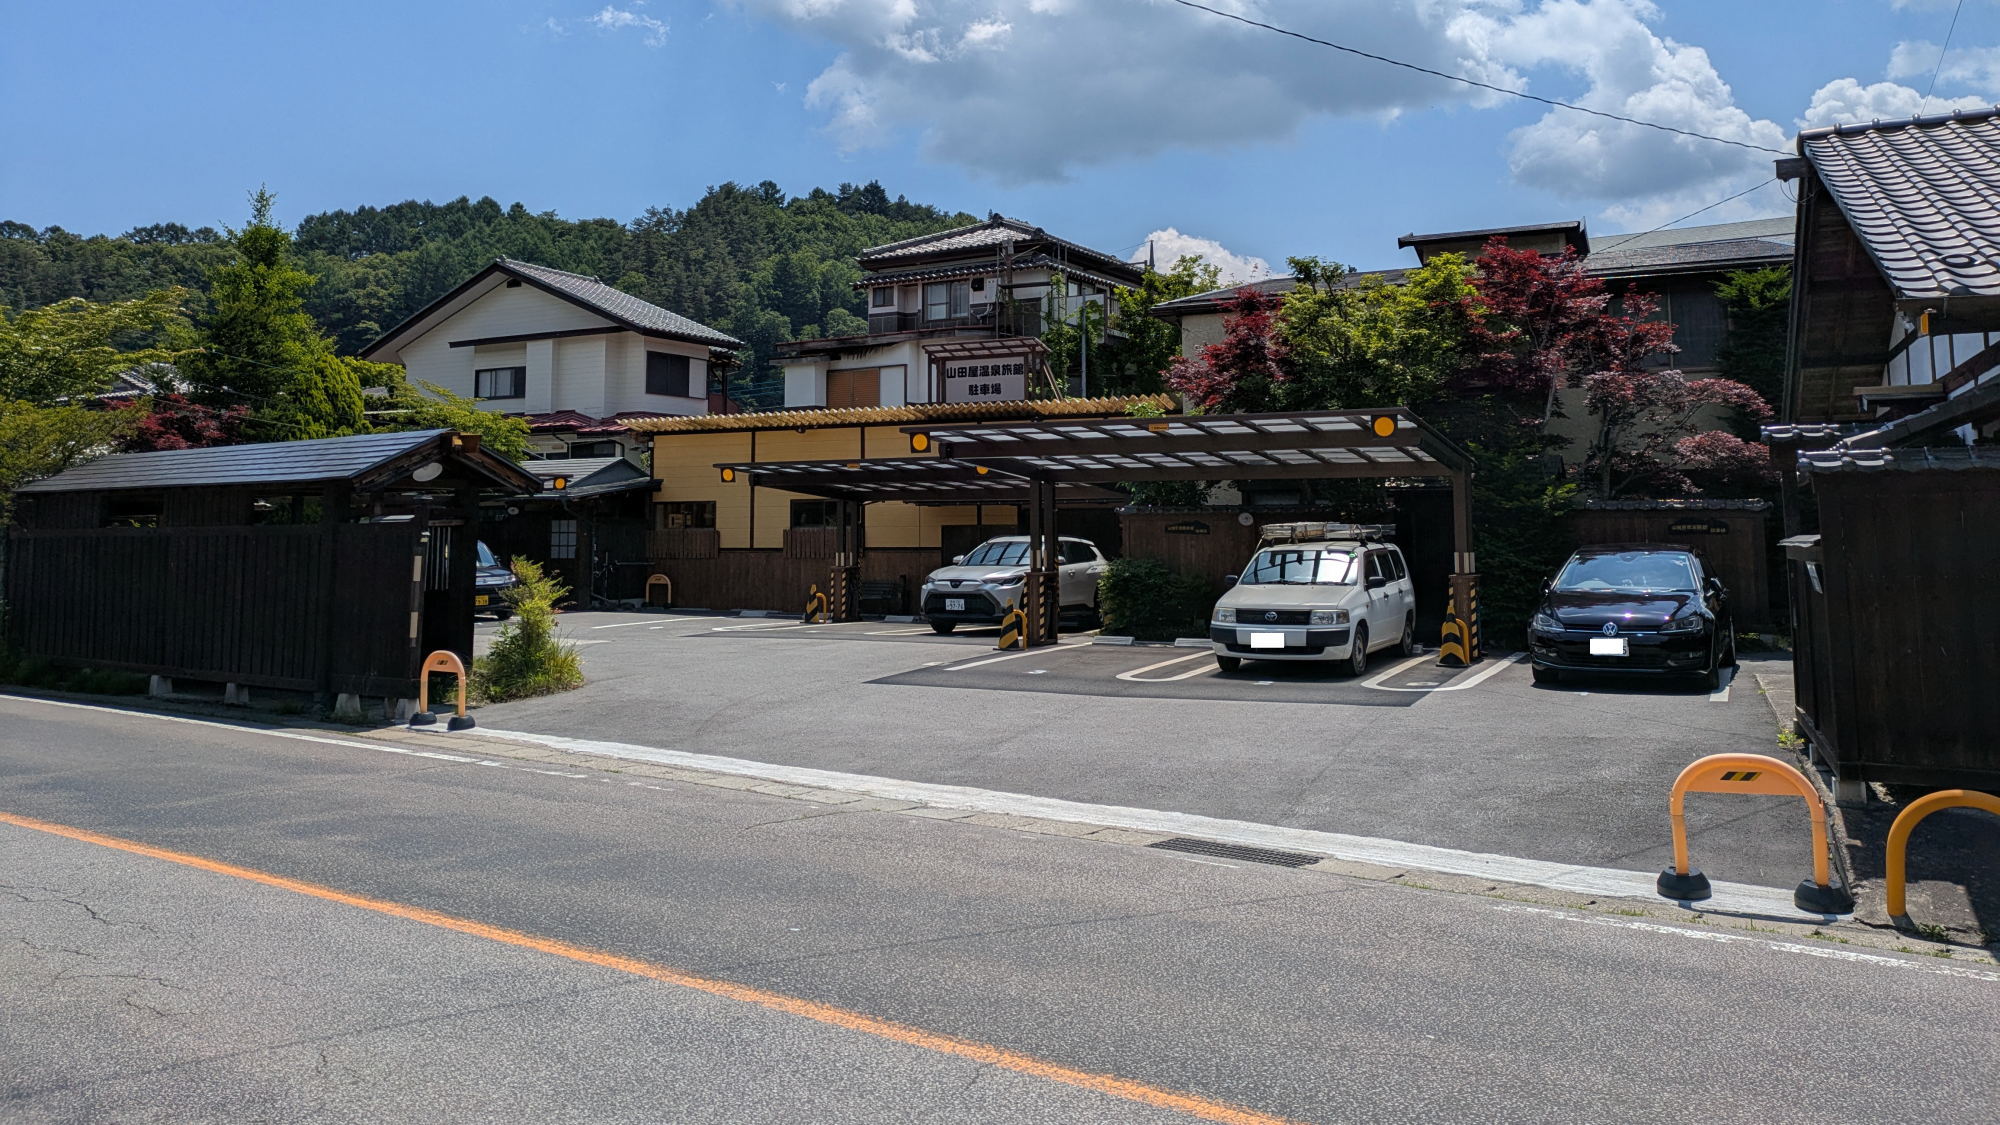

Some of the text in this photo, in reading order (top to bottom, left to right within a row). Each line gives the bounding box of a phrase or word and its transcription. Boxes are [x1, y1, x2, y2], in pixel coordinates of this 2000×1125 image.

[946, 363, 1024, 379] 山田屋温泉旅館
[968, 383, 1002, 396] 駐車場
